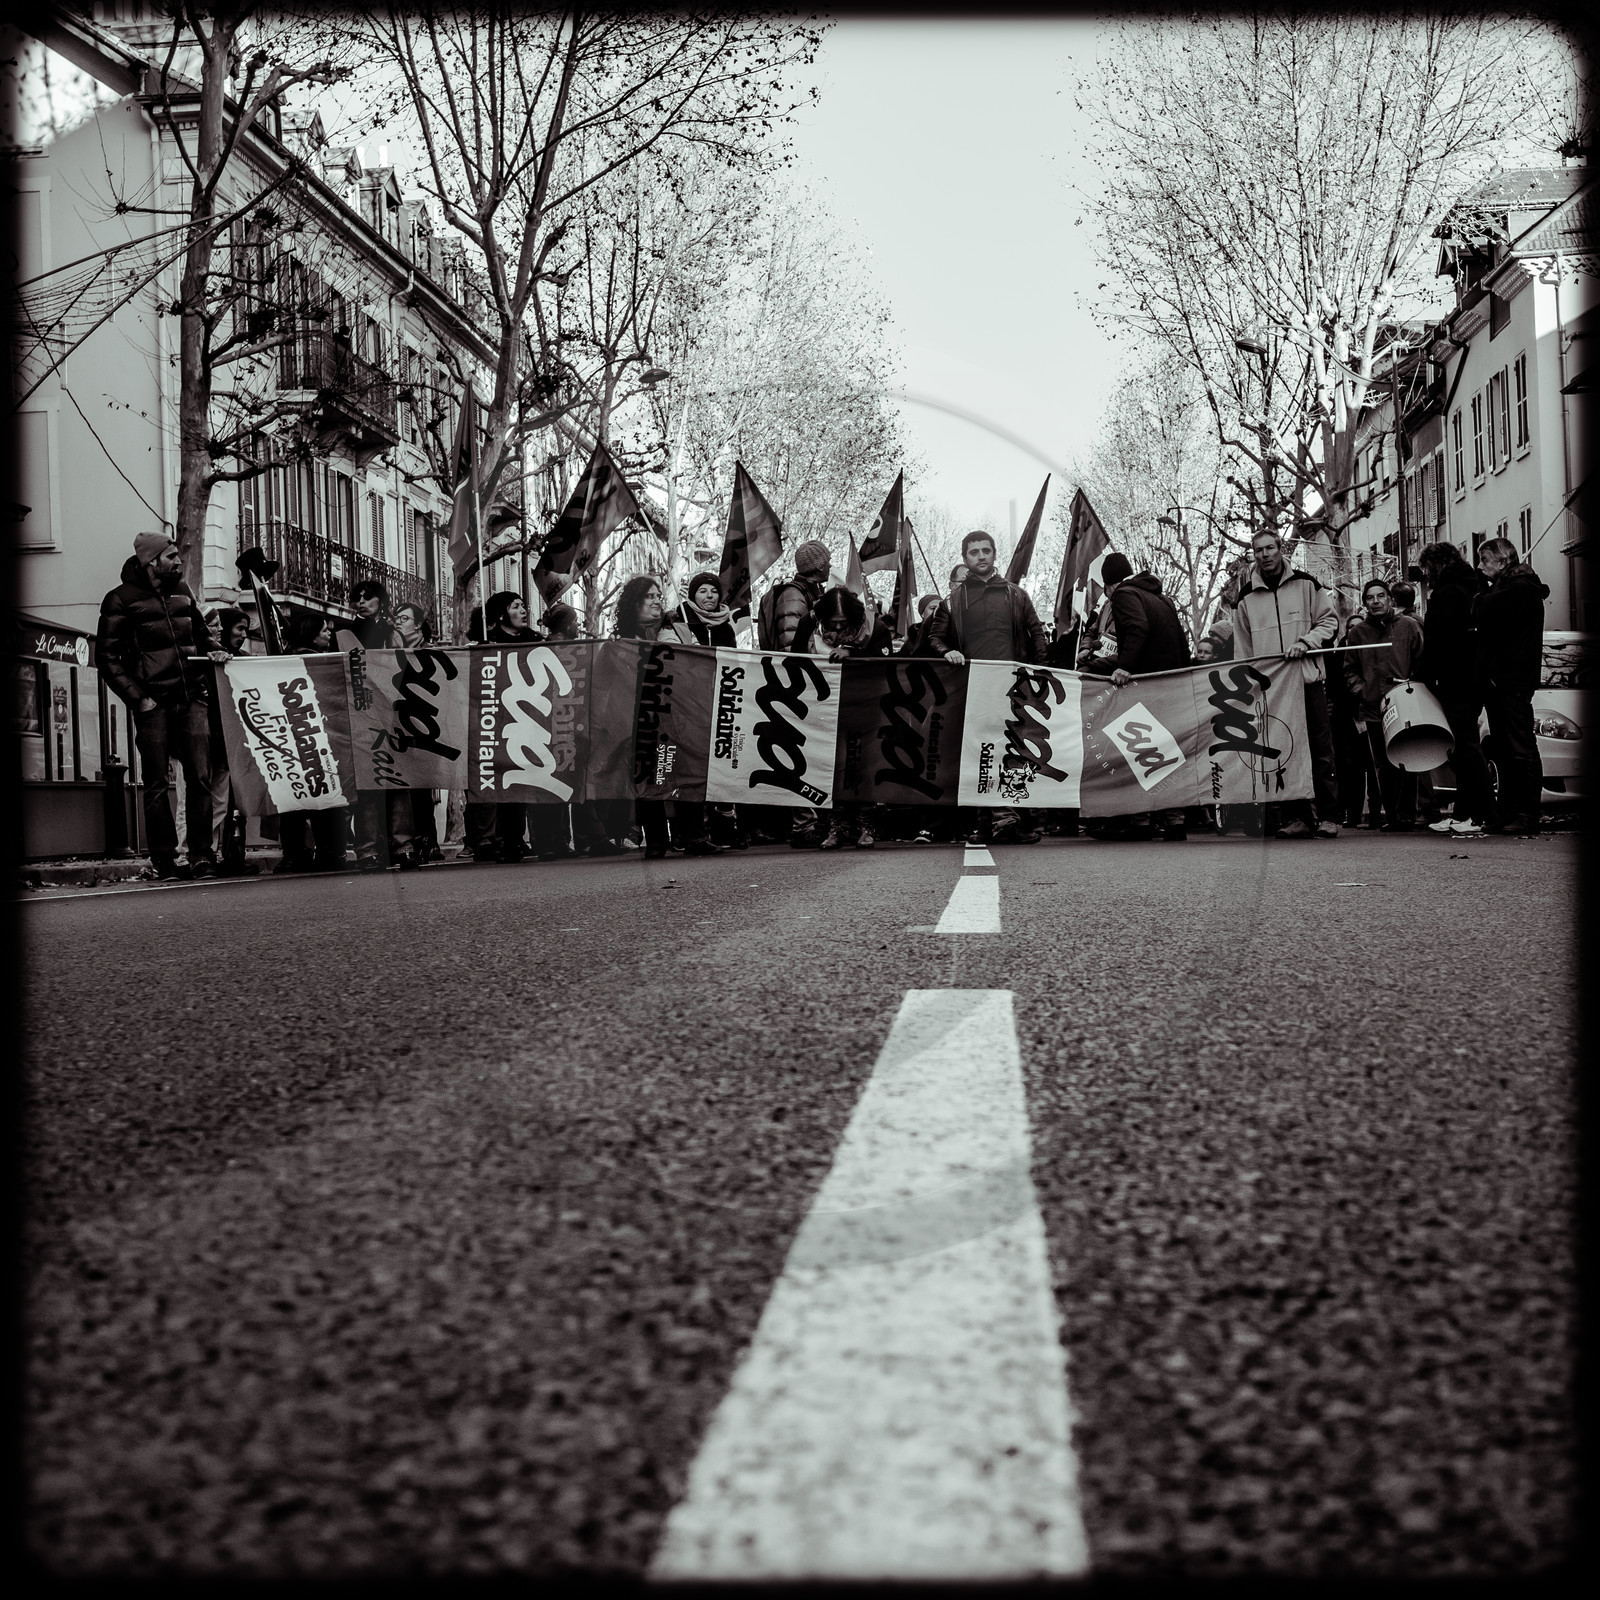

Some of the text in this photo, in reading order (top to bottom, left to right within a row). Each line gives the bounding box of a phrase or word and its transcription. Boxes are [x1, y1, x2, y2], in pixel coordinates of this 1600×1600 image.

[35, 633, 47, 653] Le
[242, 687, 282, 782] Publiques
[277, 677, 329, 798] Solidaires
[391, 649, 461, 761] Sud
[478, 651, 501, 791] Territoriaux
[501, 646, 574, 802] Sud
[714, 665, 745, 760] Solidaires
[749, 656, 831, 806] Sud
[874, 662, 947, 801] Sud
[1004, 667, 1069, 783] Sud
[1116, 721, 1180, 779] Sud
[1208, 664, 1282, 760] Sud
[270, 714, 308, 800] Finances
[368, 726, 410, 787] Rail
[655, 743, 667, 786] syndicale
[665, 744, 677, 774] Union
[800, 784, 824, 803] PTT
[977, 742, 995, 794] Solidaires
[1209, 760, 1225, 800] Aérien
